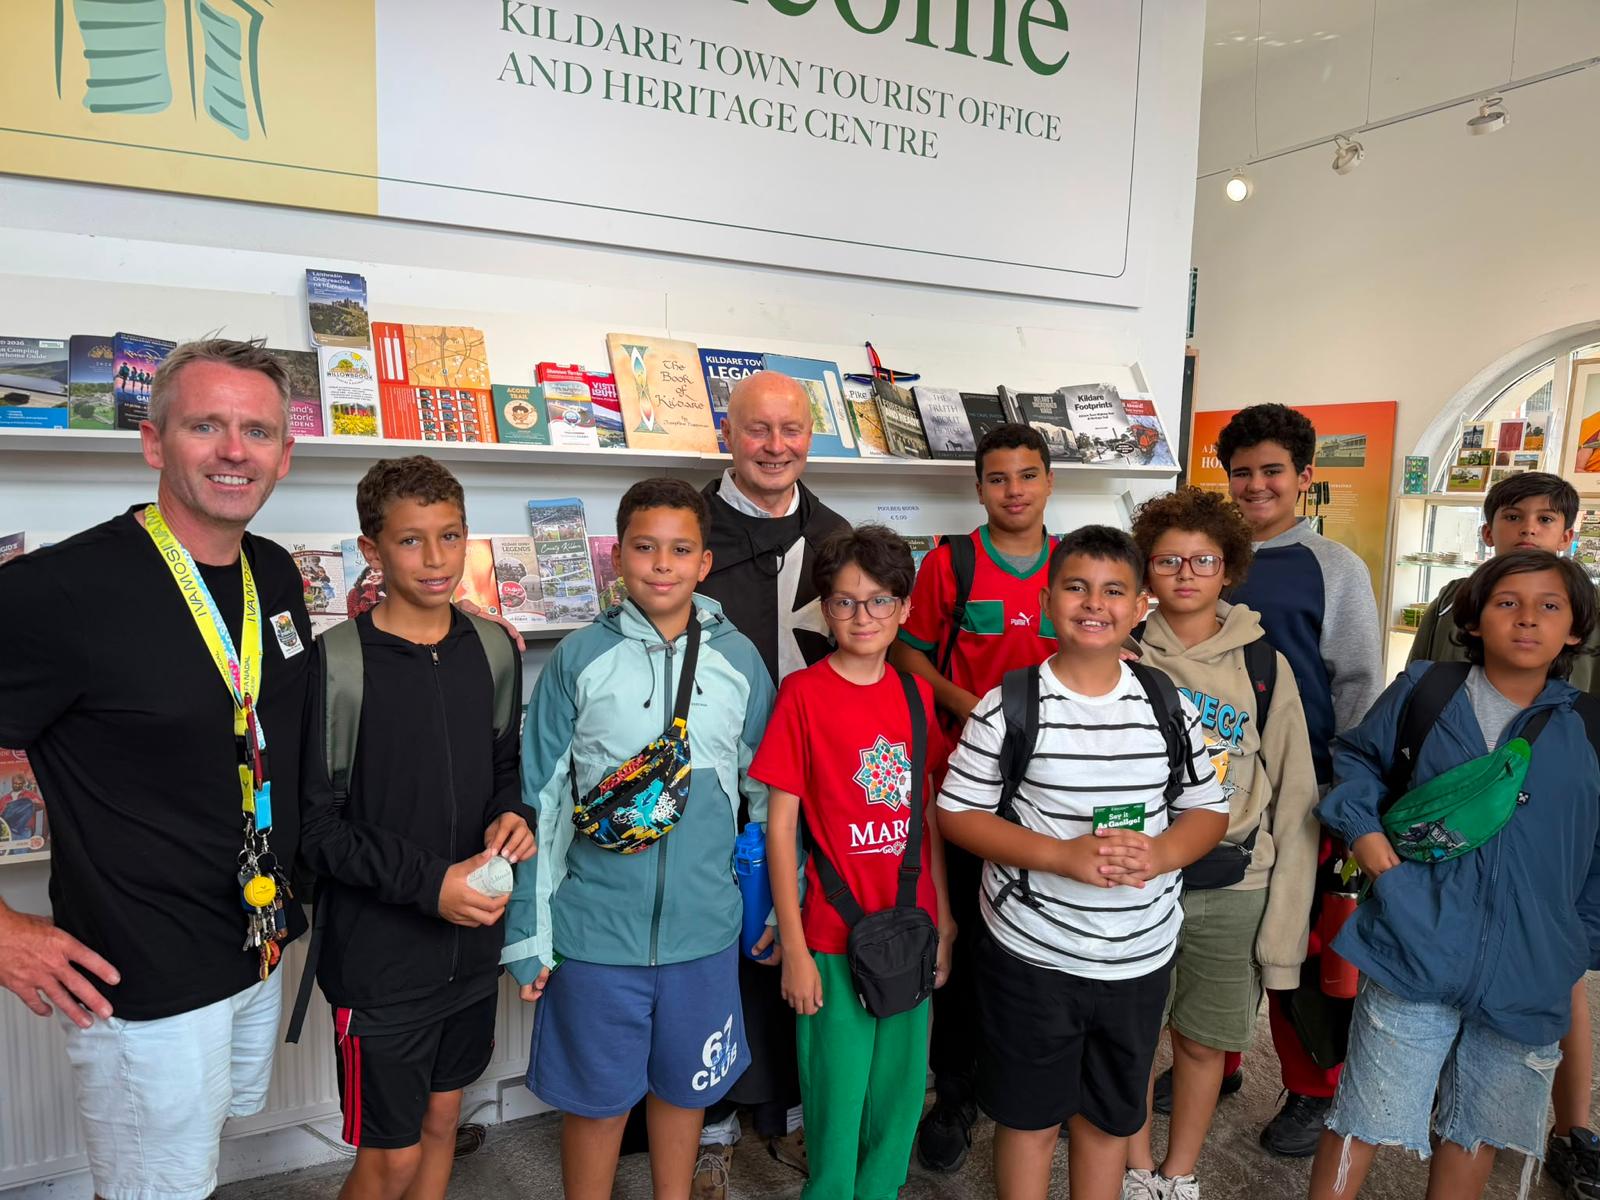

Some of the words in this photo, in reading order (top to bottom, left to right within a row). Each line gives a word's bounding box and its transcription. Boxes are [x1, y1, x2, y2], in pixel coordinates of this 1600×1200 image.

[500, 0, 683, 66] KILDARE
[690, 39, 803, 88] TOWN
[809, 64, 954, 119] TOURIST
[958, 97, 1061, 142] OFFICE
[497, 51, 593, 95] AND
[602, 68, 798, 134] HERITAGE
[804, 109, 939, 160] CENTRE
[662, 360, 686, 371] The
[705, 356, 742, 366] KILDARE
[660, 371, 694, 384] Book
[507, 386, 530, 394] ACORN
[591, 381, 615, 391] VISIT
[933, 393, 946, 402] THE
[1077, 392, 1105, 403] Kildare
[928, 403, 958, 413] TRUTH
[1075, 400, 1113, 412] Footprints
[290, 413, 314, 421] storic
[1109, 813, 1122, 821] Say
[1098, 822, 1108, 831] As
[848, 817, 911, 847] MAR
[691, 1041, 738, 1091] CLUB
